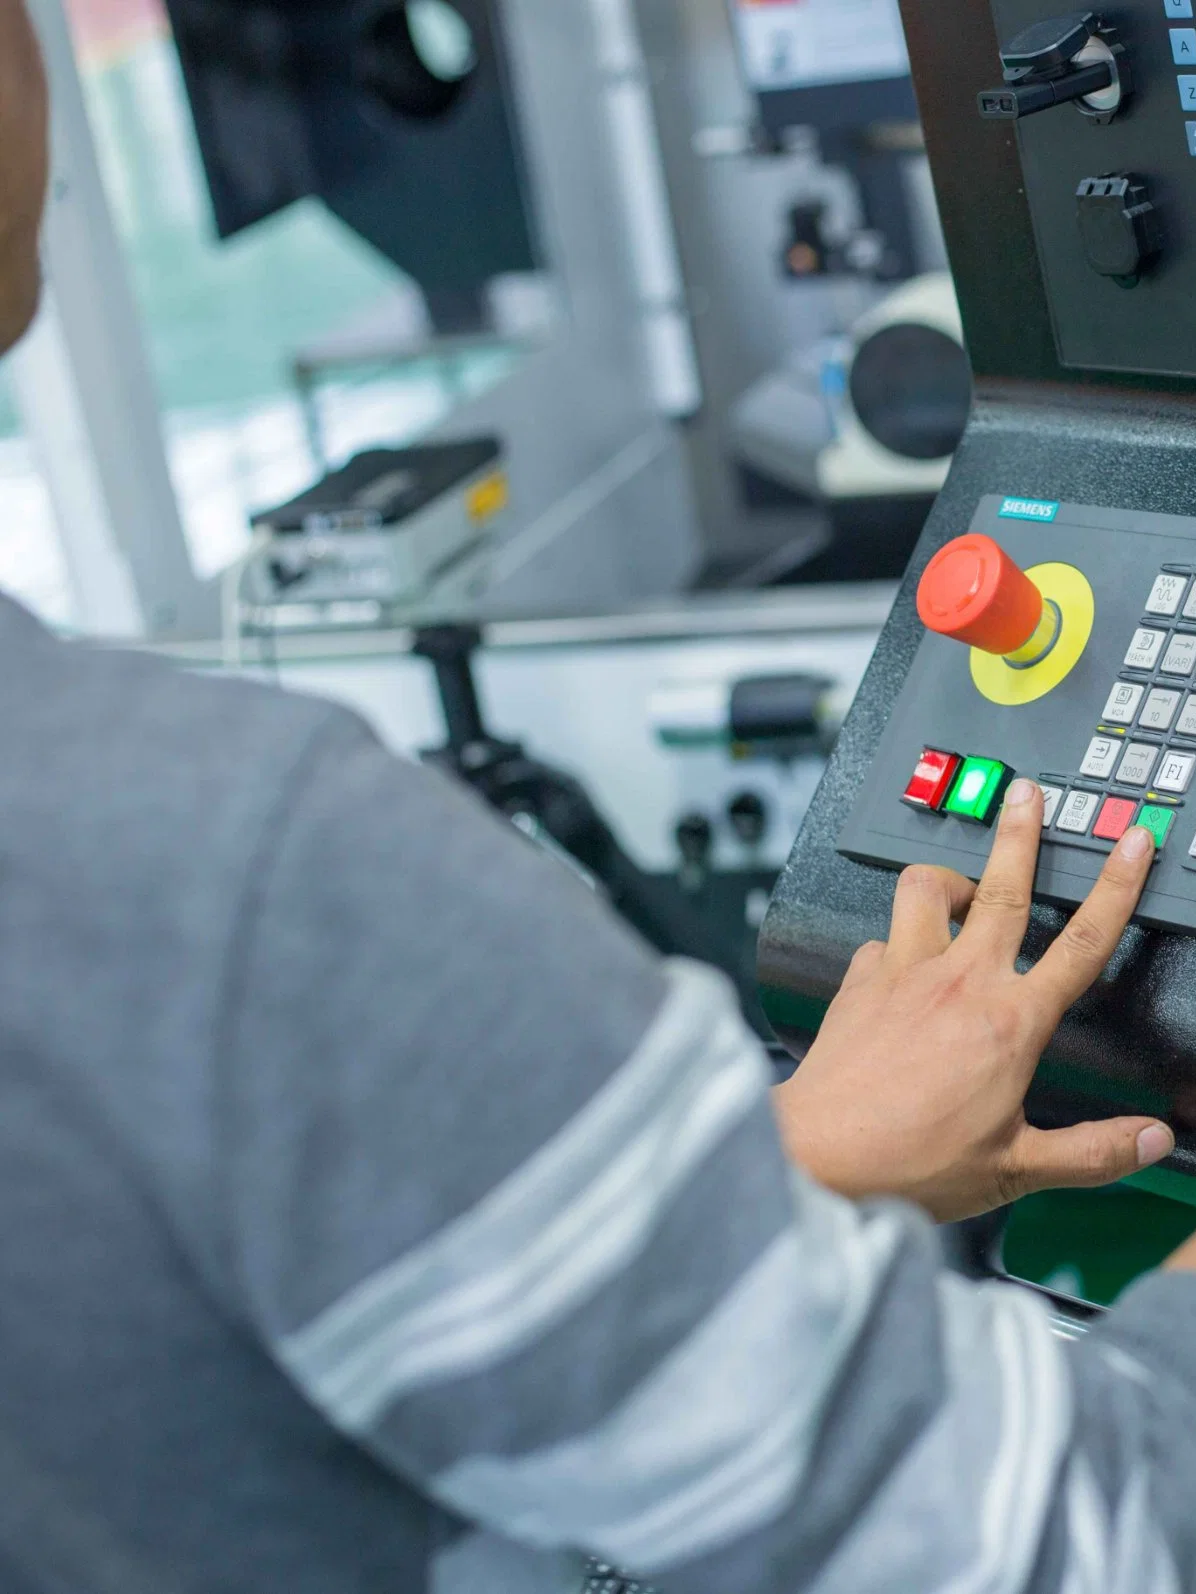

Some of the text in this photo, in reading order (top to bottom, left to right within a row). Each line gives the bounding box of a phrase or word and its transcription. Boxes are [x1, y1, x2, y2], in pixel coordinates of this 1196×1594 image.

[1180, 40, 1190, 53] A
[1188, 87, 1196, 100] Z
[1001, 500, 1054, 517] SIEMENS
[1150, 711, 1161, 723] 10
[1086, 762, 1105, 772] AUTO
[1122, 765, 1144, 779] 1000
[1164, 763, 1185, 781] F1
[1064, 809, 1086, 820] SINGLE
[1062, 817, 1081, 828] BLOCK
